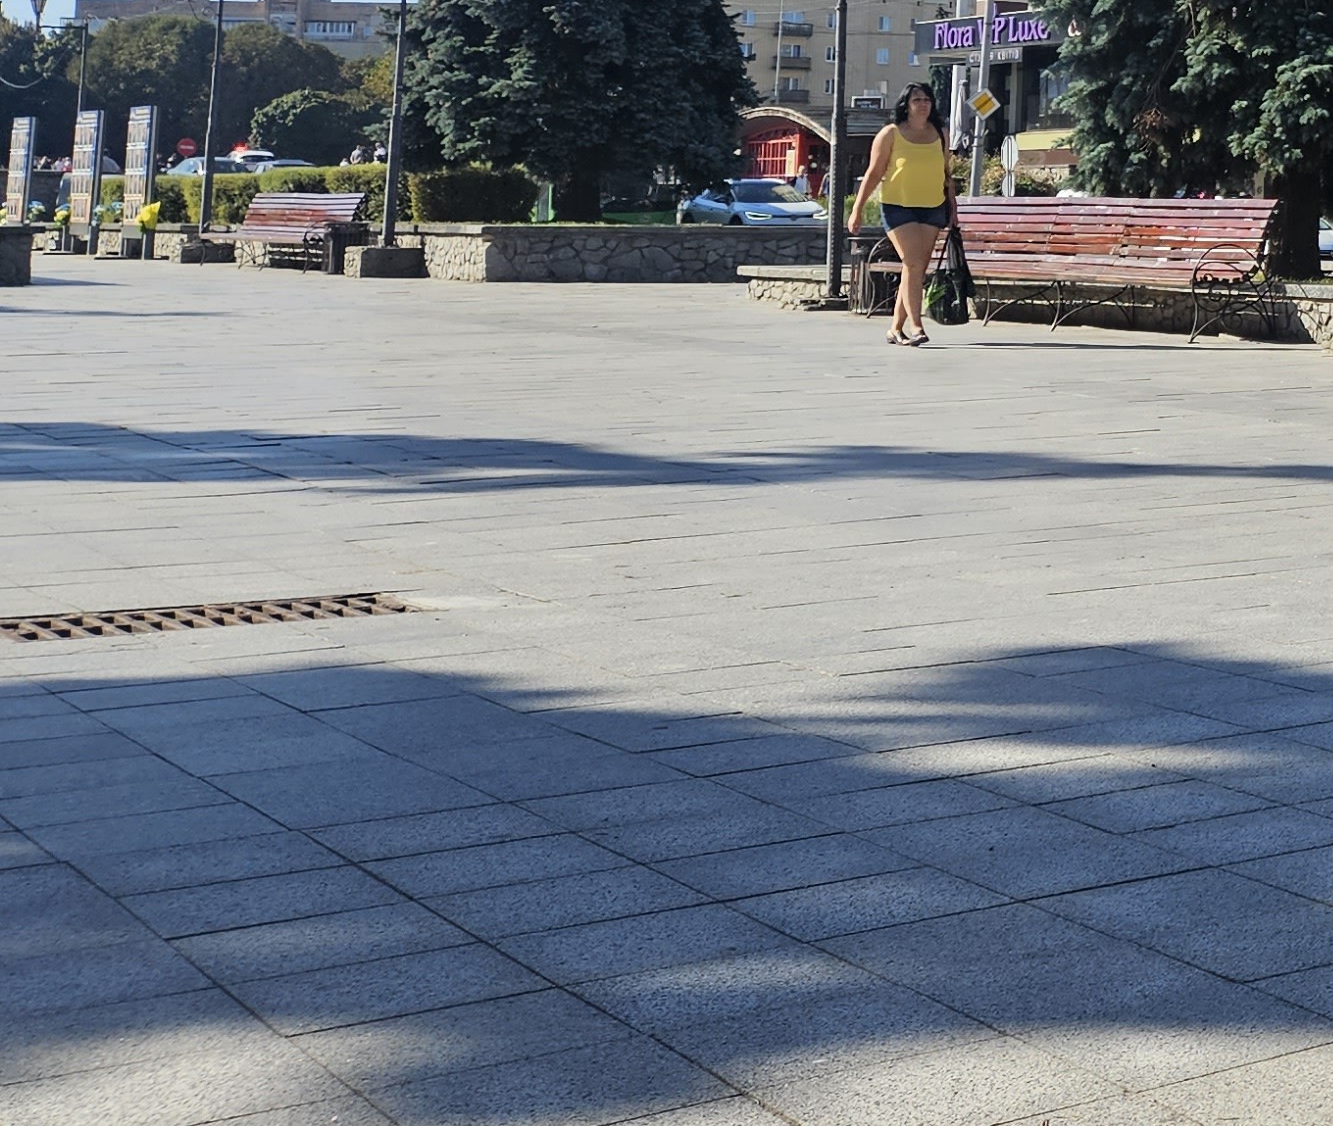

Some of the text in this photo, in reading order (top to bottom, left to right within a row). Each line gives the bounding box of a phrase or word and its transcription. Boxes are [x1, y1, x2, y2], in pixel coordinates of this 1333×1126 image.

[934, 3, 1049, 49] Flora VP Luxe
